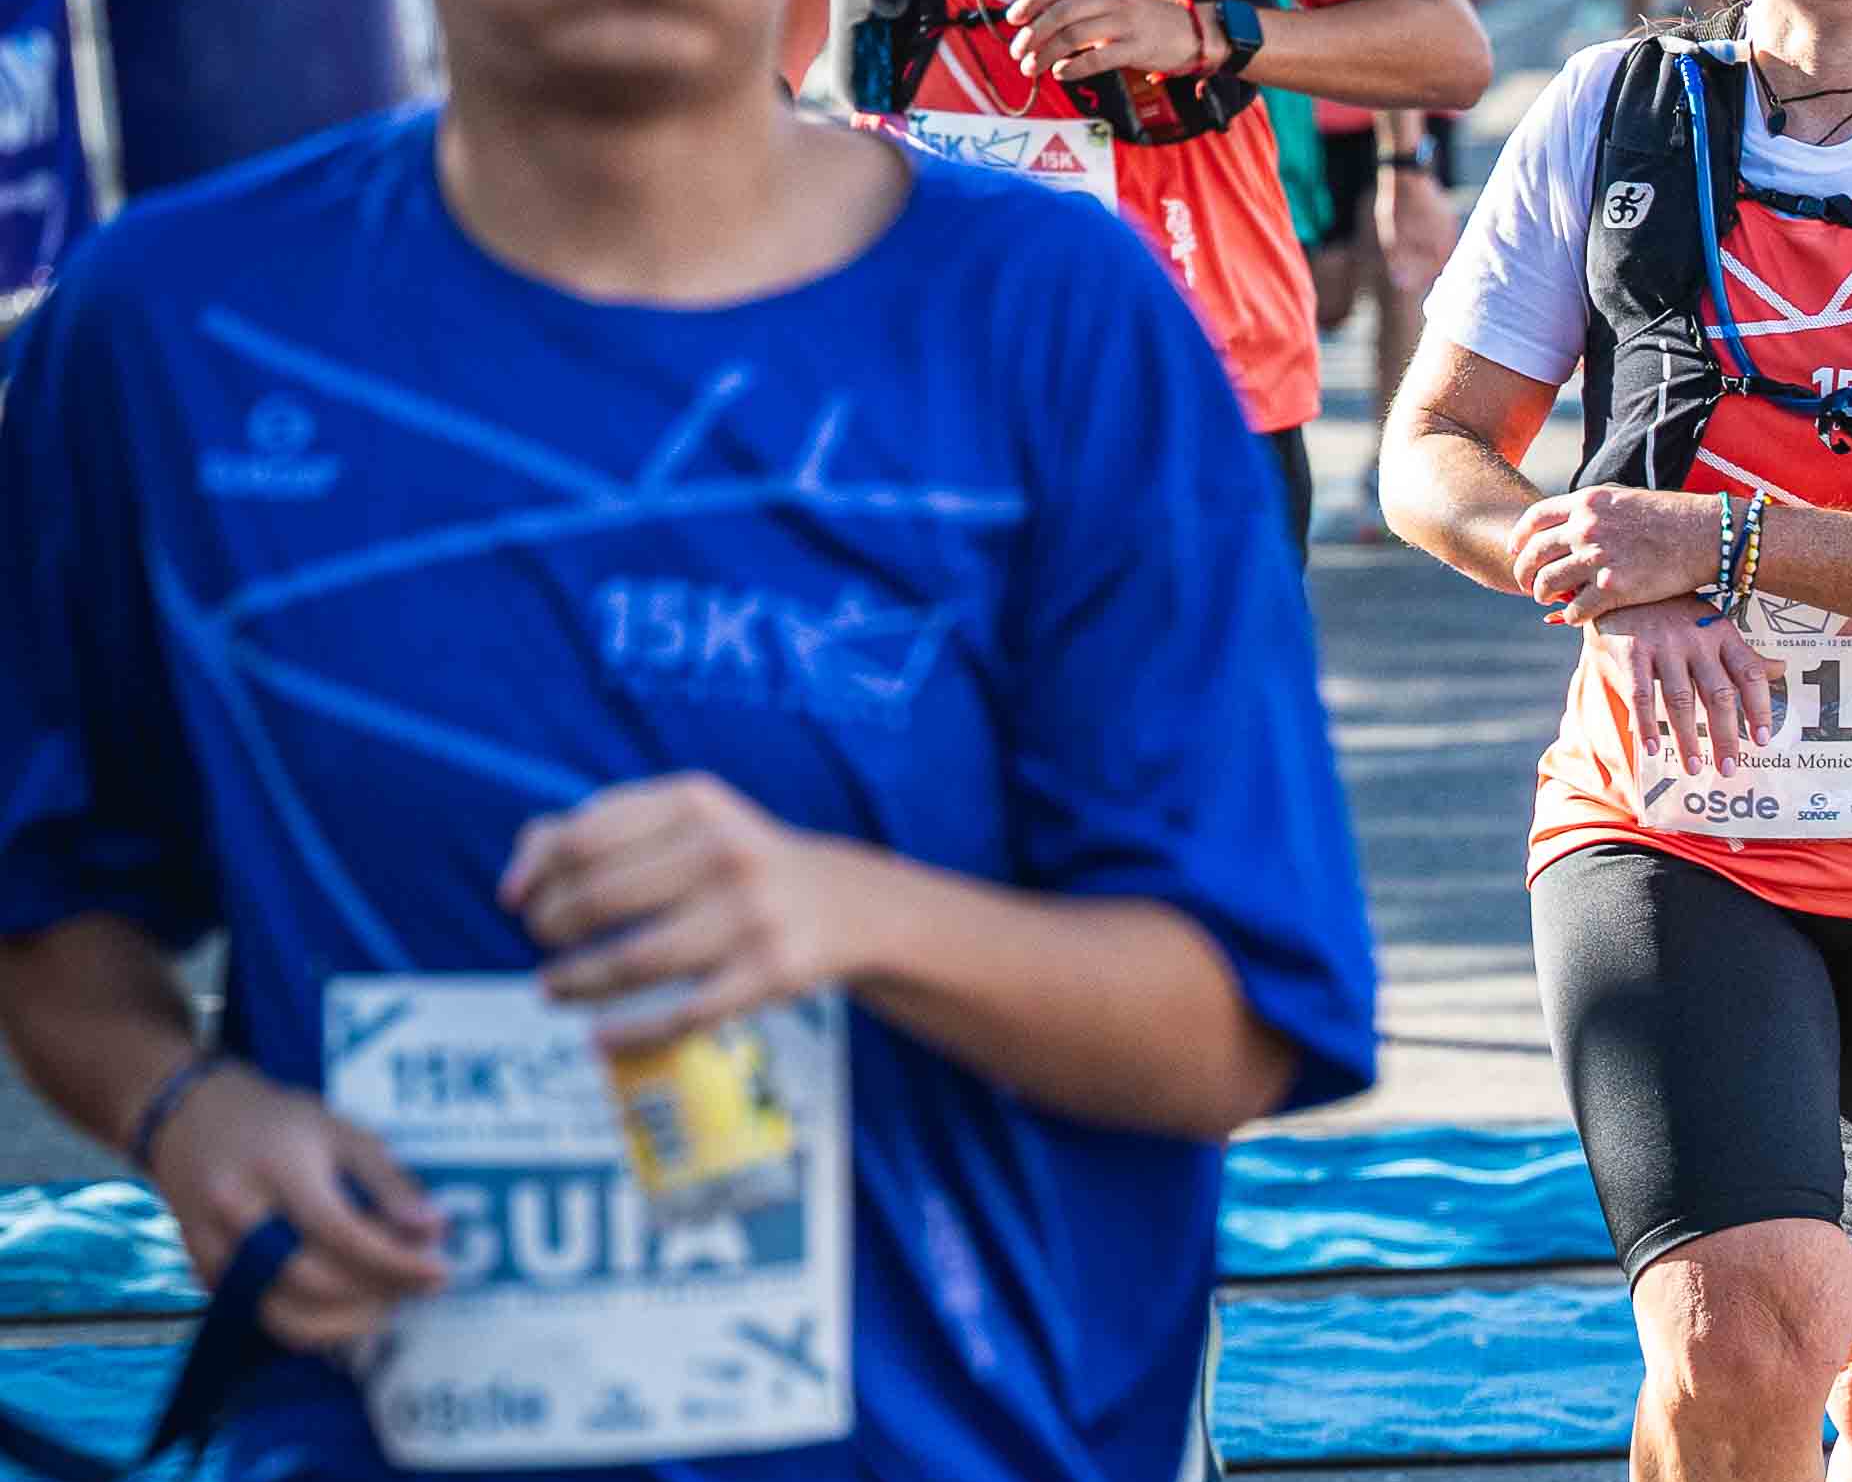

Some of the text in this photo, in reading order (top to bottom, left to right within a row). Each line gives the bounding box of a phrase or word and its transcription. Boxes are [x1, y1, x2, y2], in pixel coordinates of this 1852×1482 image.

[1776, 638, 1817, 647] ROSARIO
[1840, 639, 1852, 647] DE
[1737, 751, 1791, 769] Rueda
[1683, 788, 1780, 820] osde
